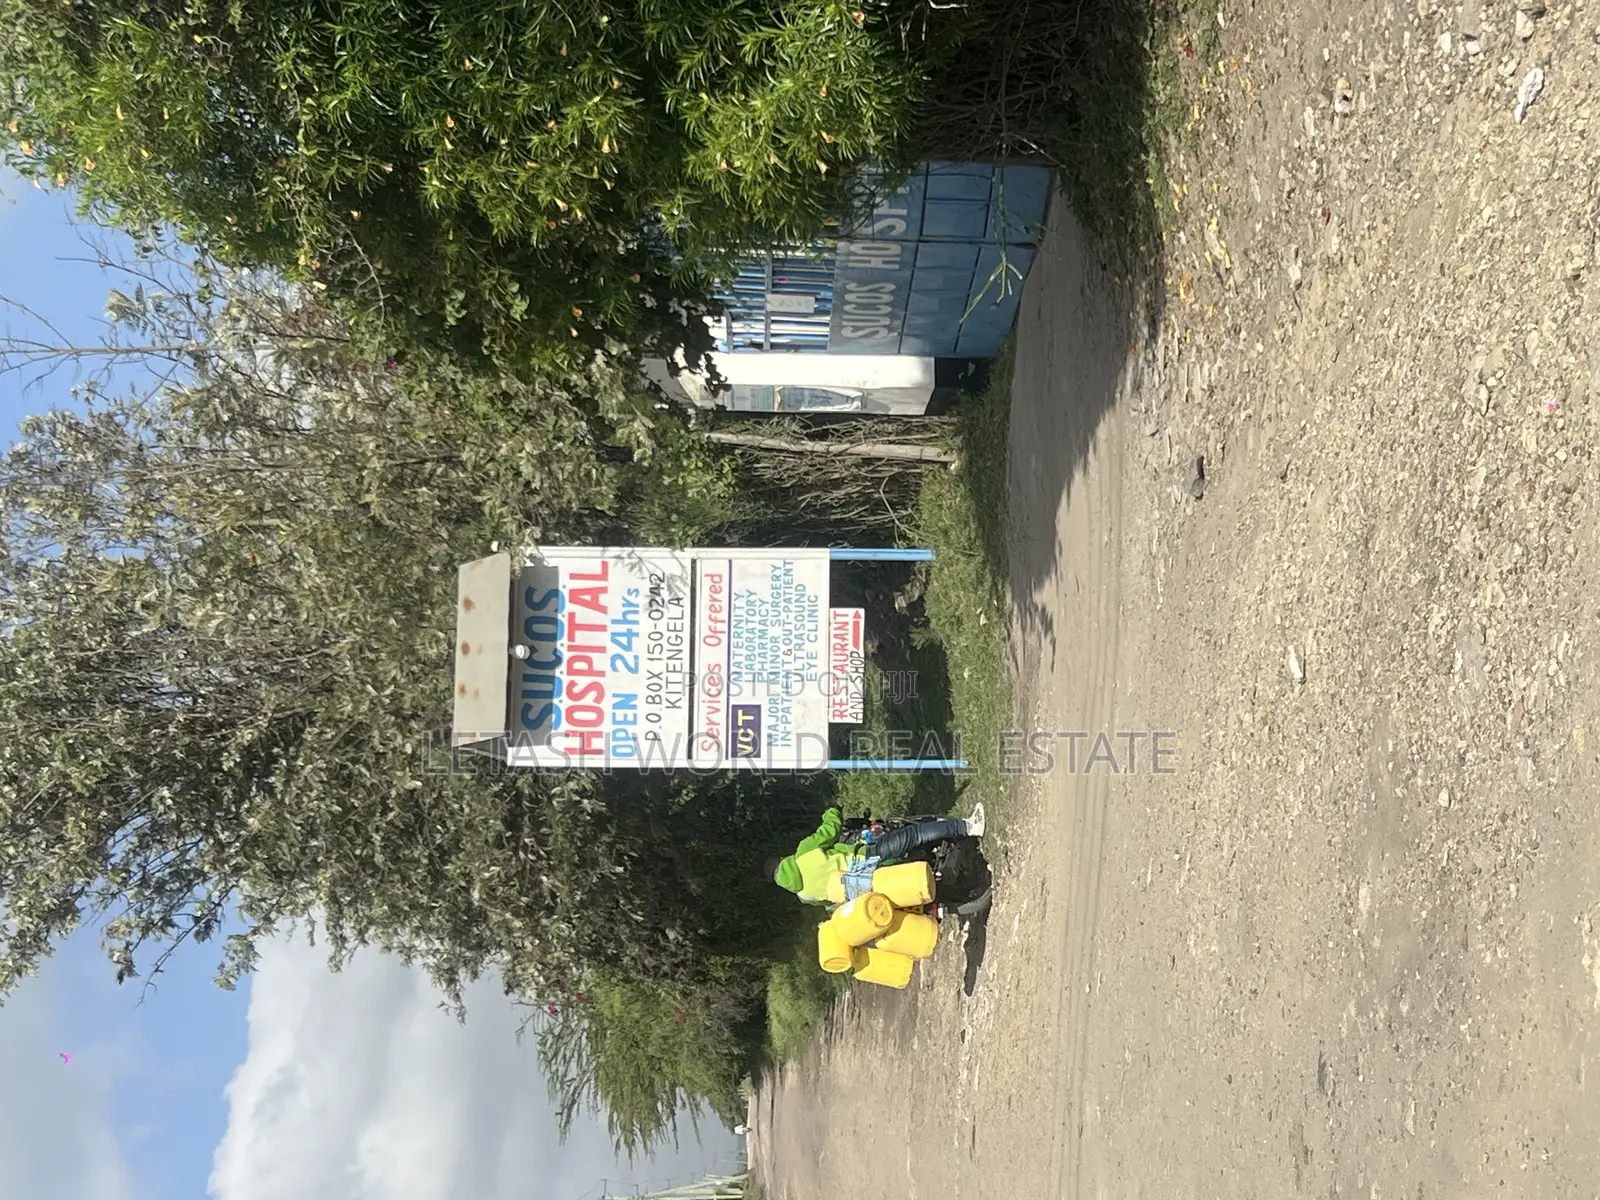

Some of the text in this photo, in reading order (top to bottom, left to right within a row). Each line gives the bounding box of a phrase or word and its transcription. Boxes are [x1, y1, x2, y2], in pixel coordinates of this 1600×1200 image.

[840, 282, 897, 339] SUCOS
[564, 560, 609, 755] HOSPITAL
[647, 571, 665, 661] 150-0242
[665, 597, 684, 710] KITENGELA
[700, 573, 726, 752] Services Offered
[732, 591, 745, 683] MATERNITY
[745, 589, 757, 683] LABORATORY
[757, 598, 769, 683] PHARMACY
[767, 564, 782, 747] MAJOR MINOR SURGERY
[780, 559, 794, 748] IN-PATIENT & OUT-PATIENT
[794, 583, 806, 683] ULTRASOUND
[806, 594, 819, 682] EYE CLINIC
[610, 588, 640, 758] OPEN 24hrs
[832, 610, 849, 720] RESTAURANT
[849, 650, 864, 721] AND SHOP
[737, 709, 755, 757] VCT
